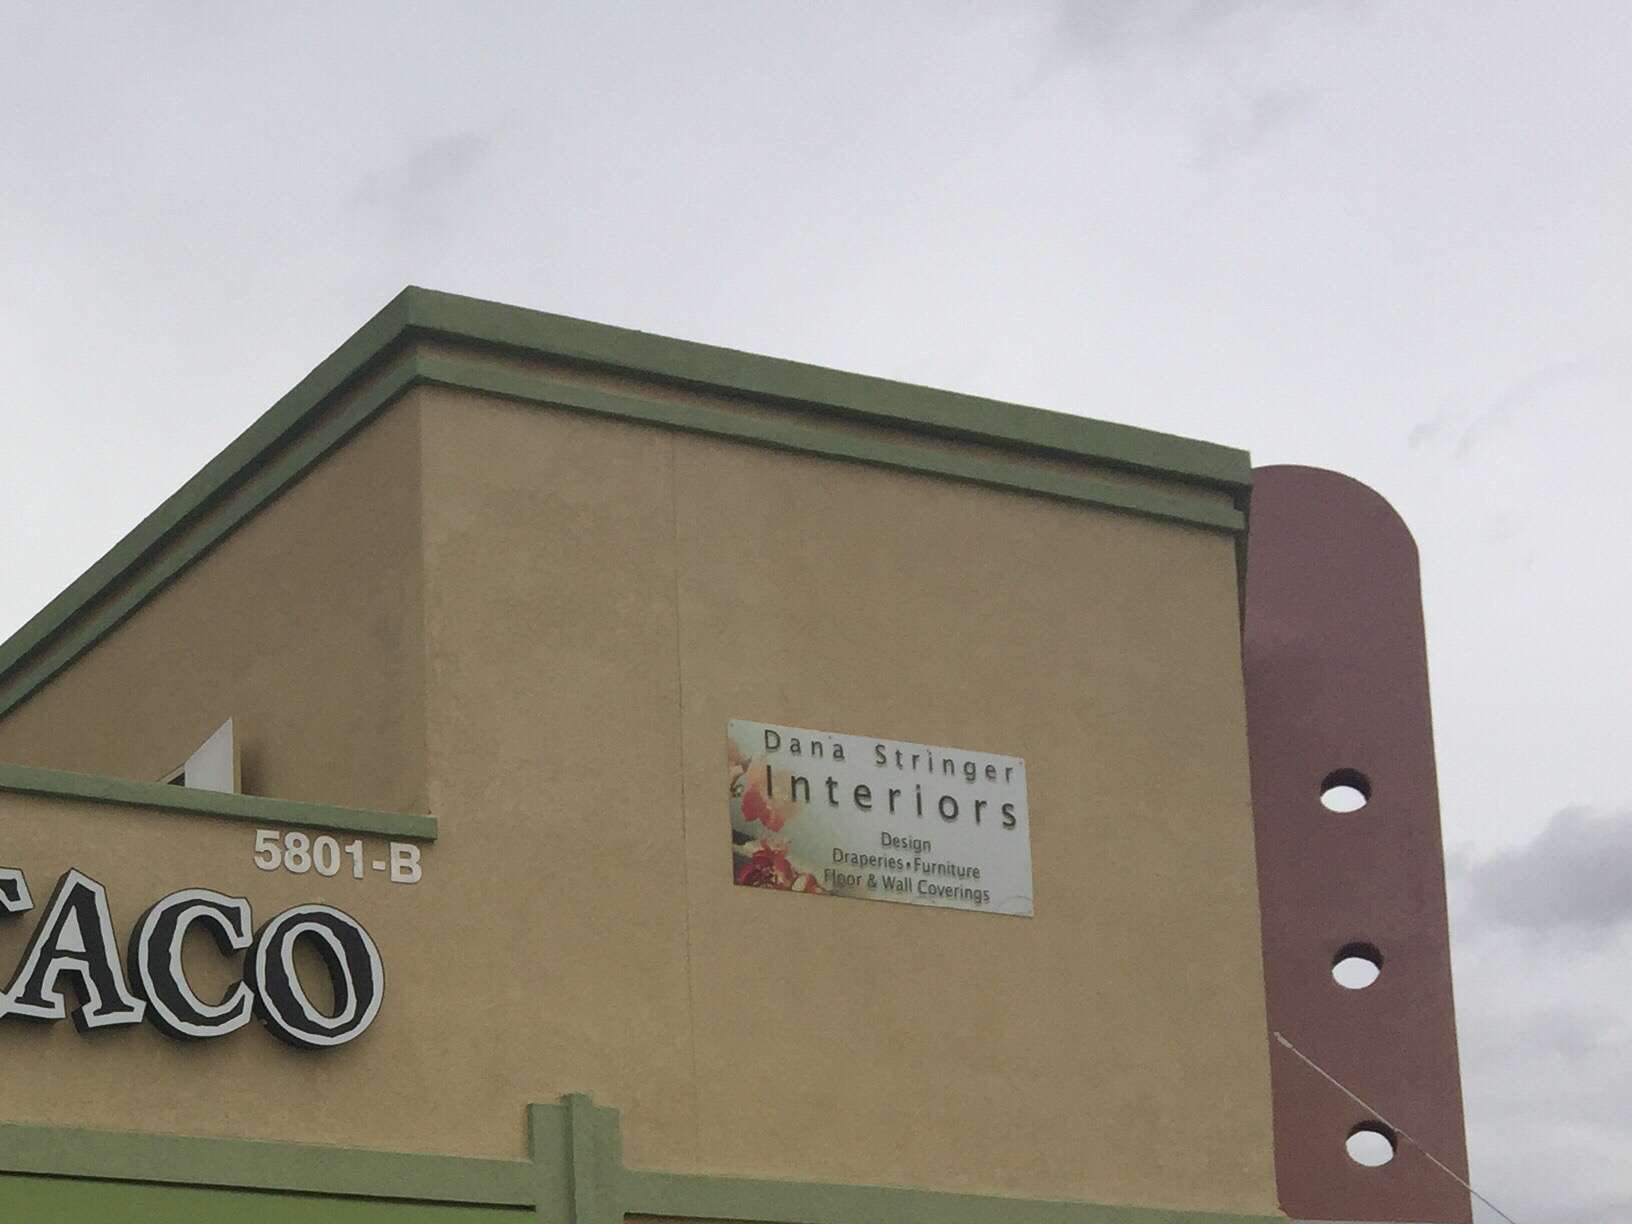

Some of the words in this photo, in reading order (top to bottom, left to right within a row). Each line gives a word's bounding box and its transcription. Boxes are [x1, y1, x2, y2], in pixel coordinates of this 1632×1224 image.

[764, 729, 846, 762] Dana
[874, 743, 1015, 785] Stringer
[765, 764, 1018, 831] Interiors
[253, 828, 424, 885] 5801-B
[832, 847, 904, 873] Draperies
[913, 857, 981, 881] Furniture
[879, 831, 932, 854] Design
[823, 868, 862, 889] Floor
[867, 873, 877, 888] &
[882, 871, 913, 894] Wall
[917, 880, 991, 904] Coverings
